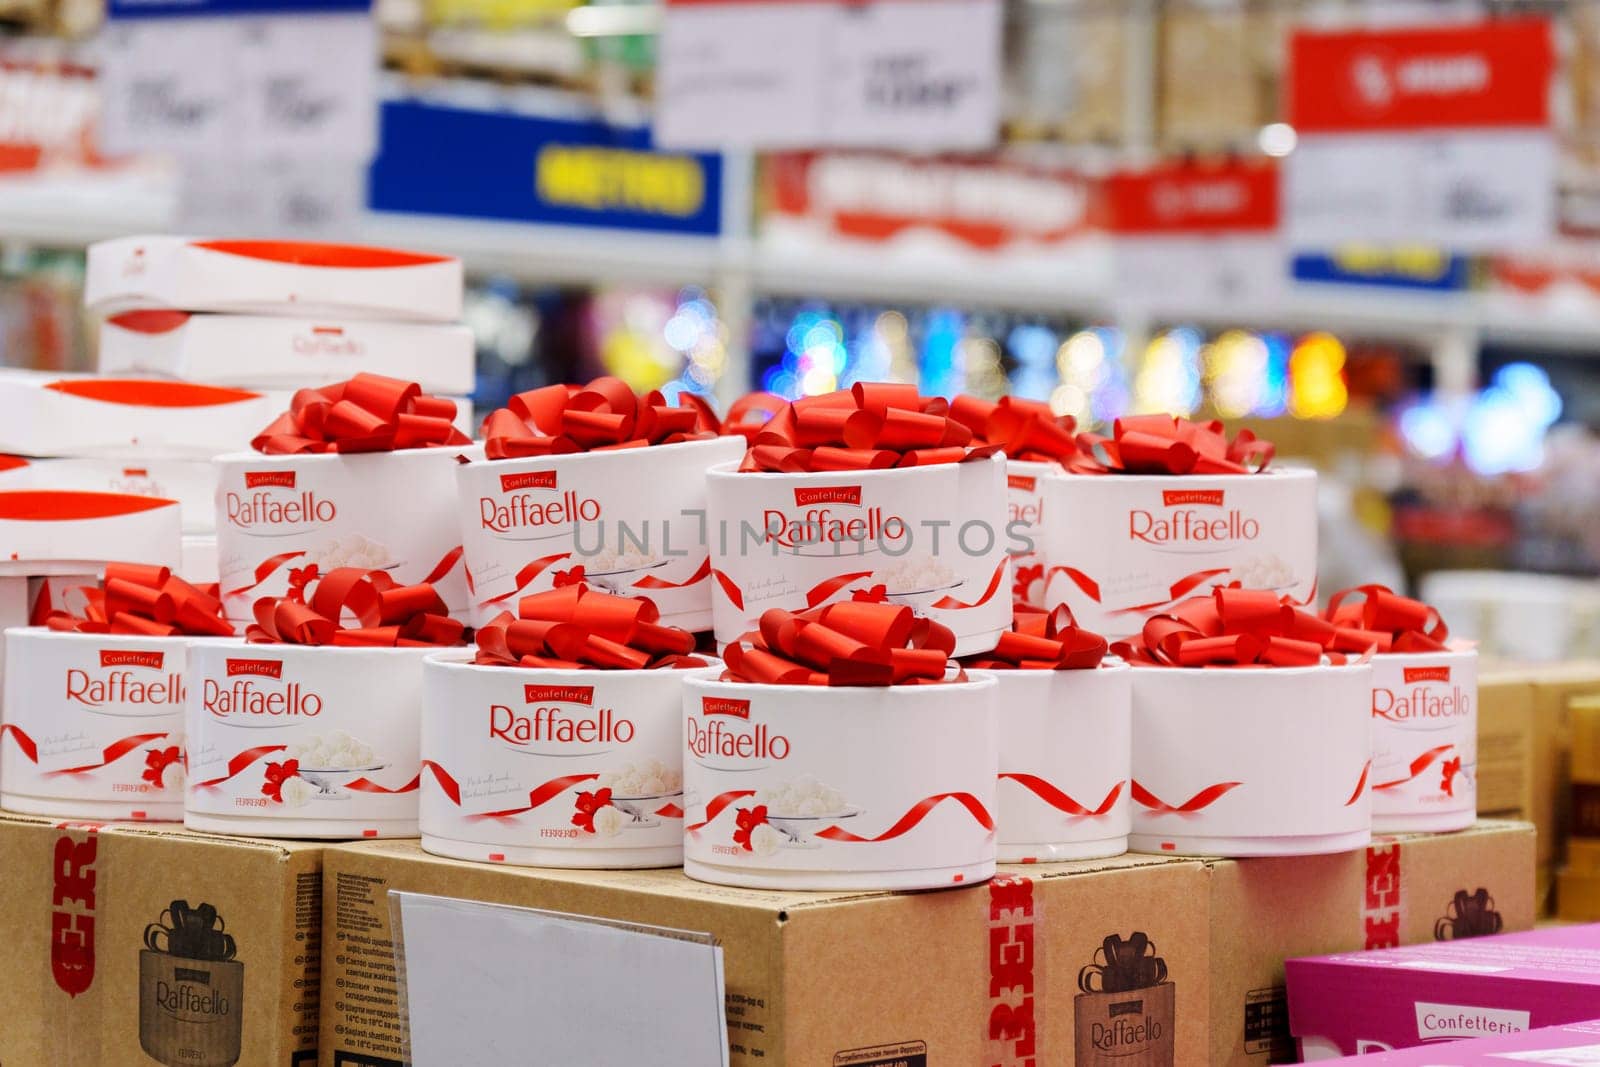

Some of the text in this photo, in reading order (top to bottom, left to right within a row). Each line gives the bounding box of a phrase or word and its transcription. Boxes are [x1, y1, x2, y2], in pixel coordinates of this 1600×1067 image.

[504, 476, 553, 489] Confetteria
[800, 490, 857, 502] Confetteria
[1167, 492, 1222, 504] Confetteria
[227, 491, 336, 528] Raffaello
[480, 490, 601, 533] Raffaello
[763, 507, 905, 548] Raffaello
[1129, 509, 1260, 546] Raffaello
[103, 654, 160, 666] Confetteria
[229, 662, 278, 675] Confetteria
[66, 669, 186, 707] Raffaell
[203, 679, 322, 717] Raffaello
[529, 690, 589, 702] Confetteria
[1372, 686, 1470, 723] Raffaello
[489, 705, 635, 746] Raffaello
[687, 717, 791, 760] Raffaello
[156, 981, 230, 1016] Raffaello
[1091, 1016, 1162, 1051] Raffaello
